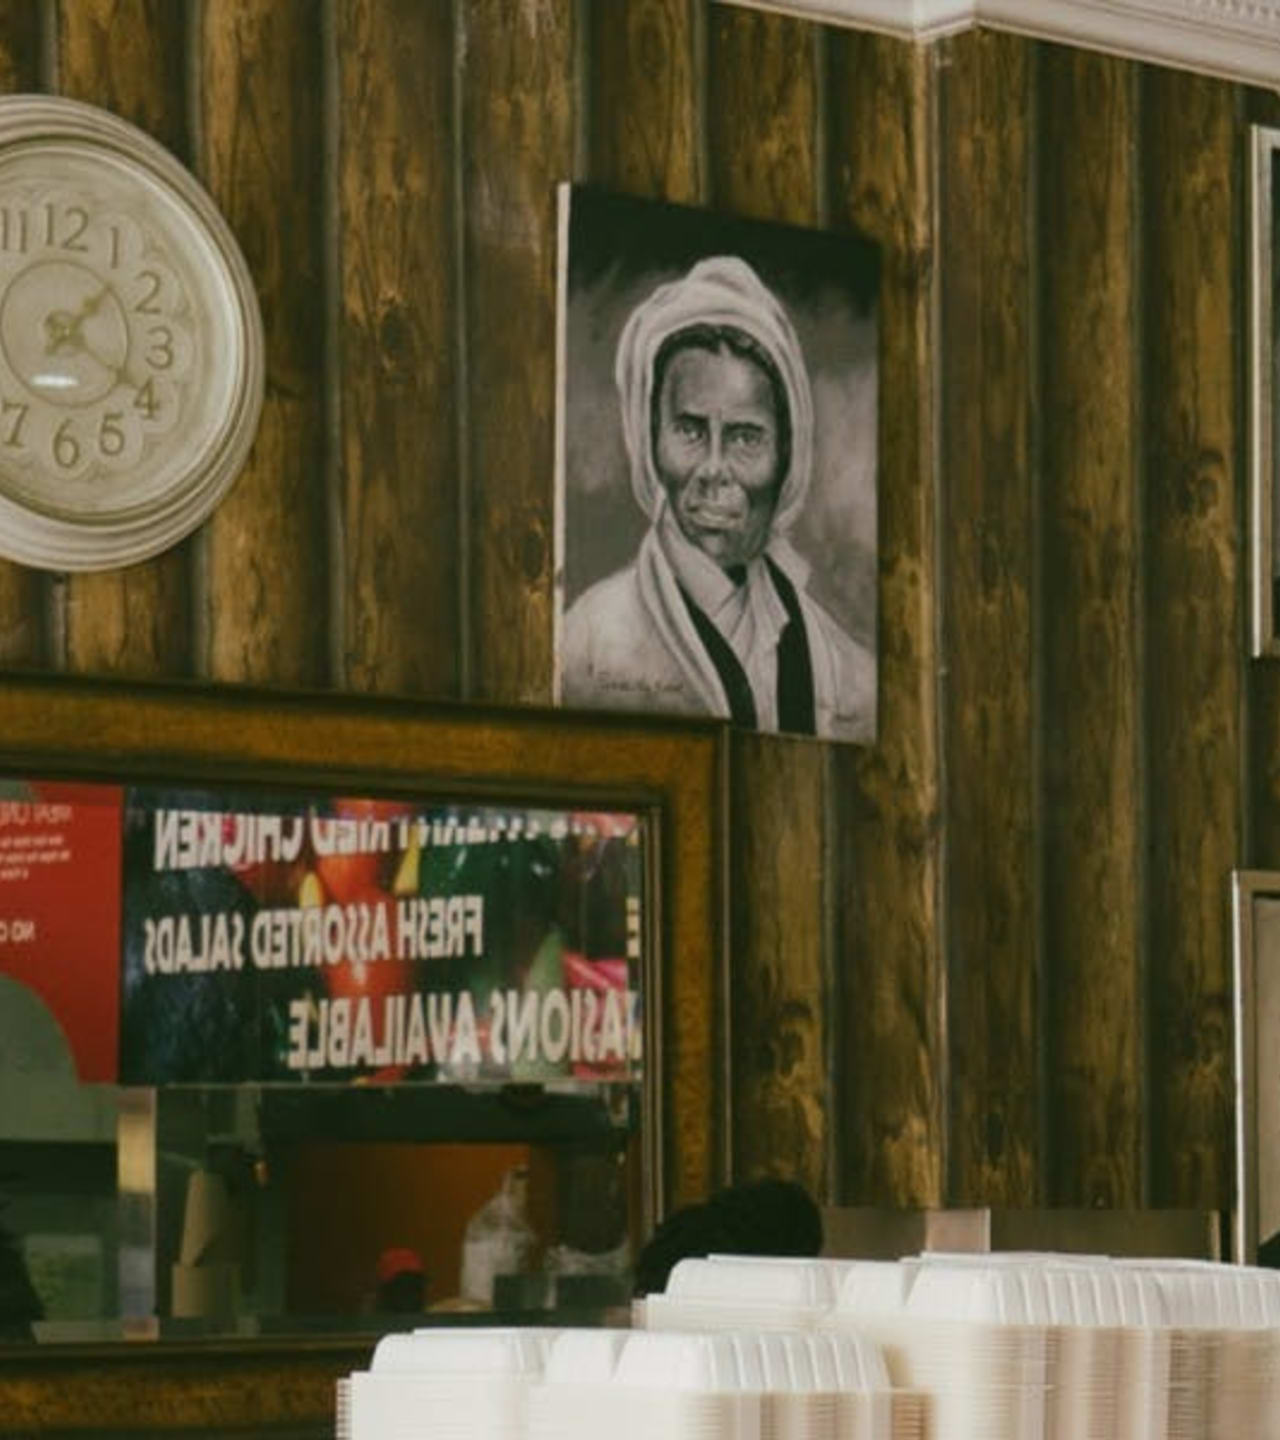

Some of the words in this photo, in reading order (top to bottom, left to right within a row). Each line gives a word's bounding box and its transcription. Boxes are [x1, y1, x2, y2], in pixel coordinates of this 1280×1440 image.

[0, 208, 28, 254] 11
[45, 203, 90, 251] 12
[109, 226, 120, 270] 1
[135, 271, 162, 315] 2
[145, 326, 175, 370] 3
[134, 376, 161, 420] 4
[2, 402, 30, 449] 7
[52, 418, 81, 470] 6
[99, 412, 126, 457] 5
